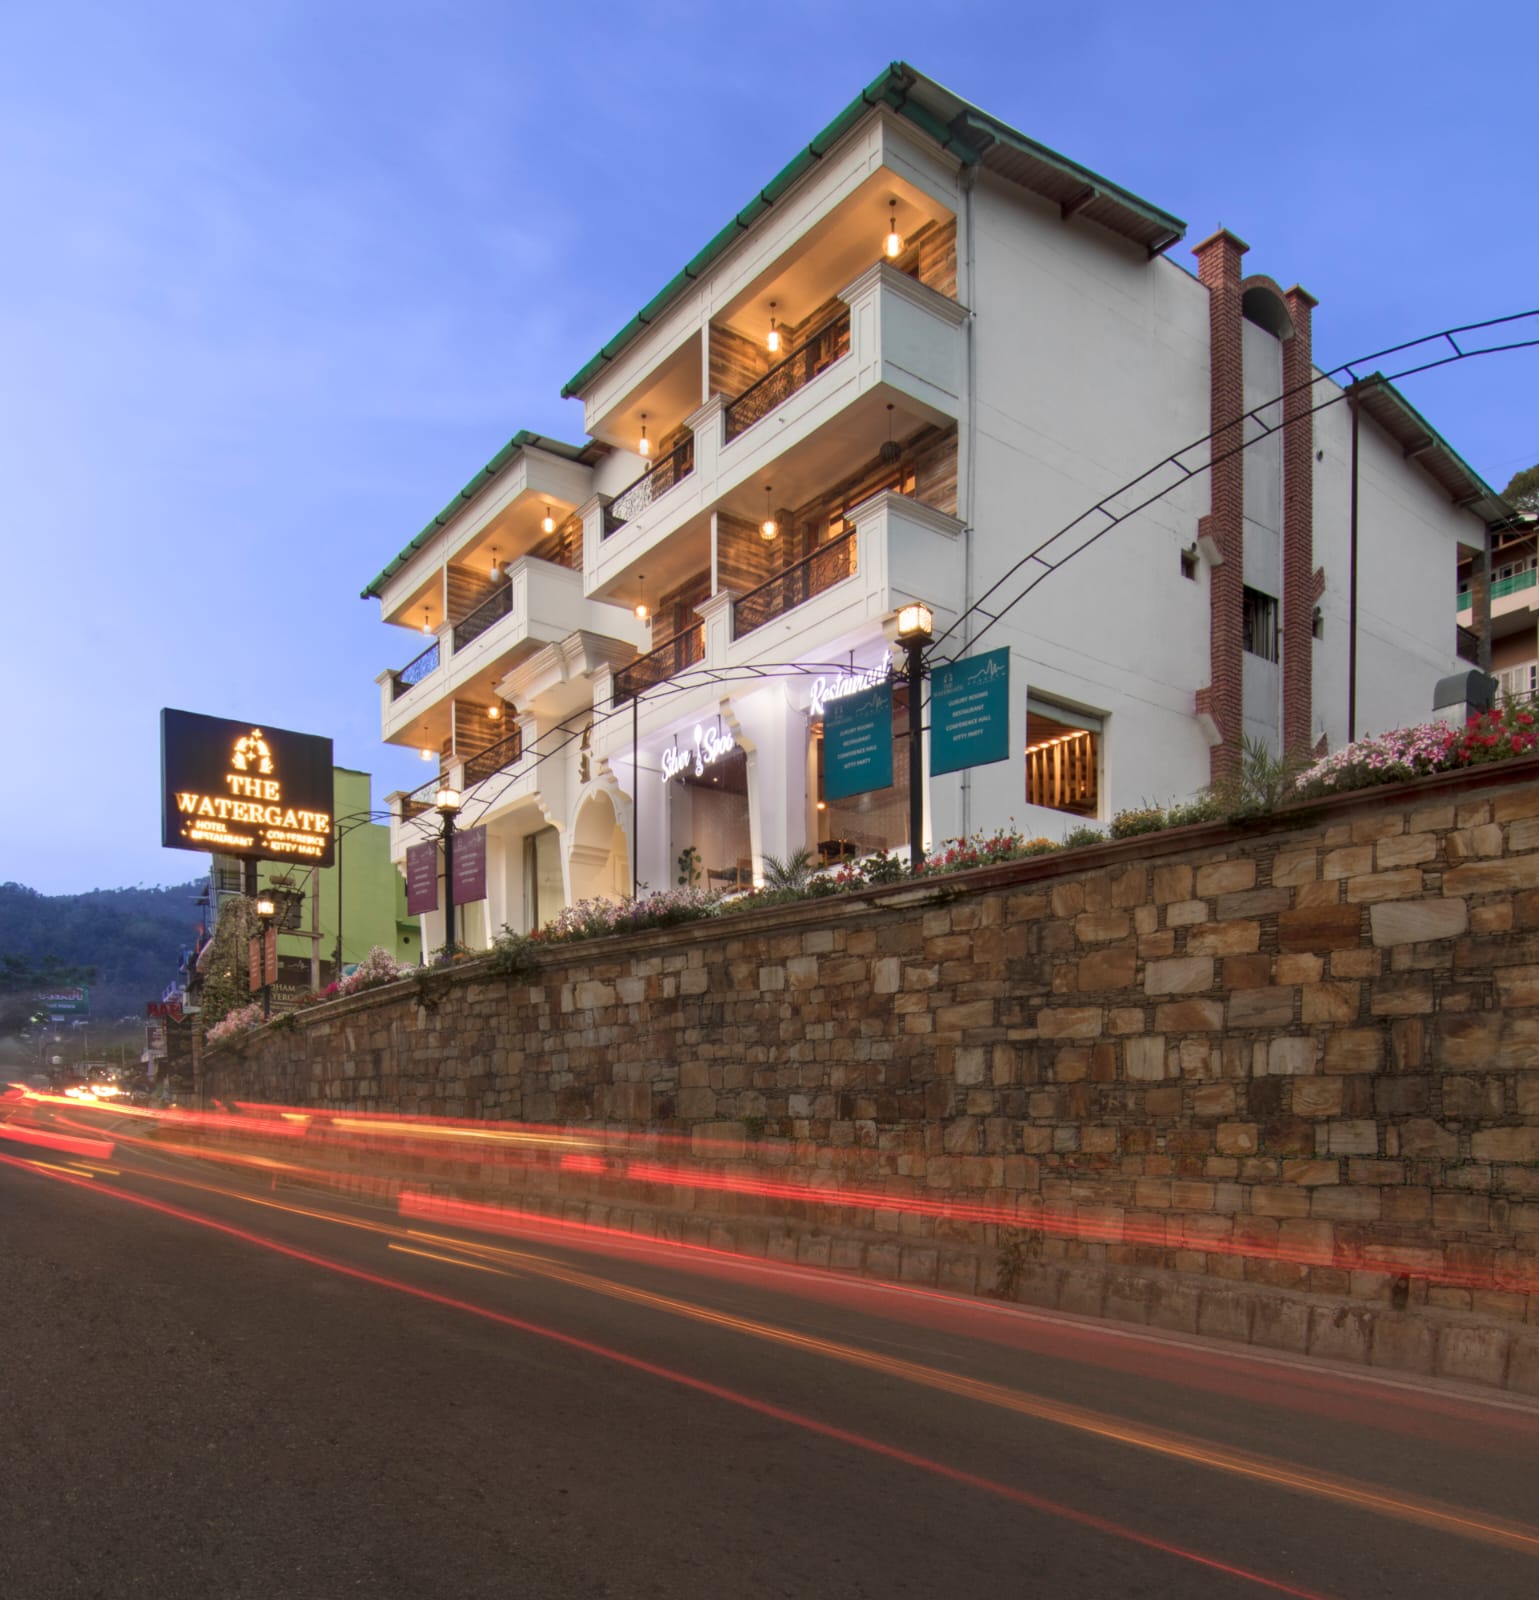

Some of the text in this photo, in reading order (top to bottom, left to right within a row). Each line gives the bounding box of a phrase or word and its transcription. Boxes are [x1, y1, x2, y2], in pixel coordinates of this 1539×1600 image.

[810, 649, 891, 716] Restaurant
[978, 713, 991, 724] HALL
[662, 727, 734, 783] Silver Spoo
[227, 774, 280, 801] THE
[176, 793, 330, 833] WATERGATE
[196, 821, 227, 834] HOTEL
[191, 830, 254, 847] RESTAURANT
[266, 830, 325, 847] CONFERENCE
[271, 841, 322, 857] KITTY HALL
